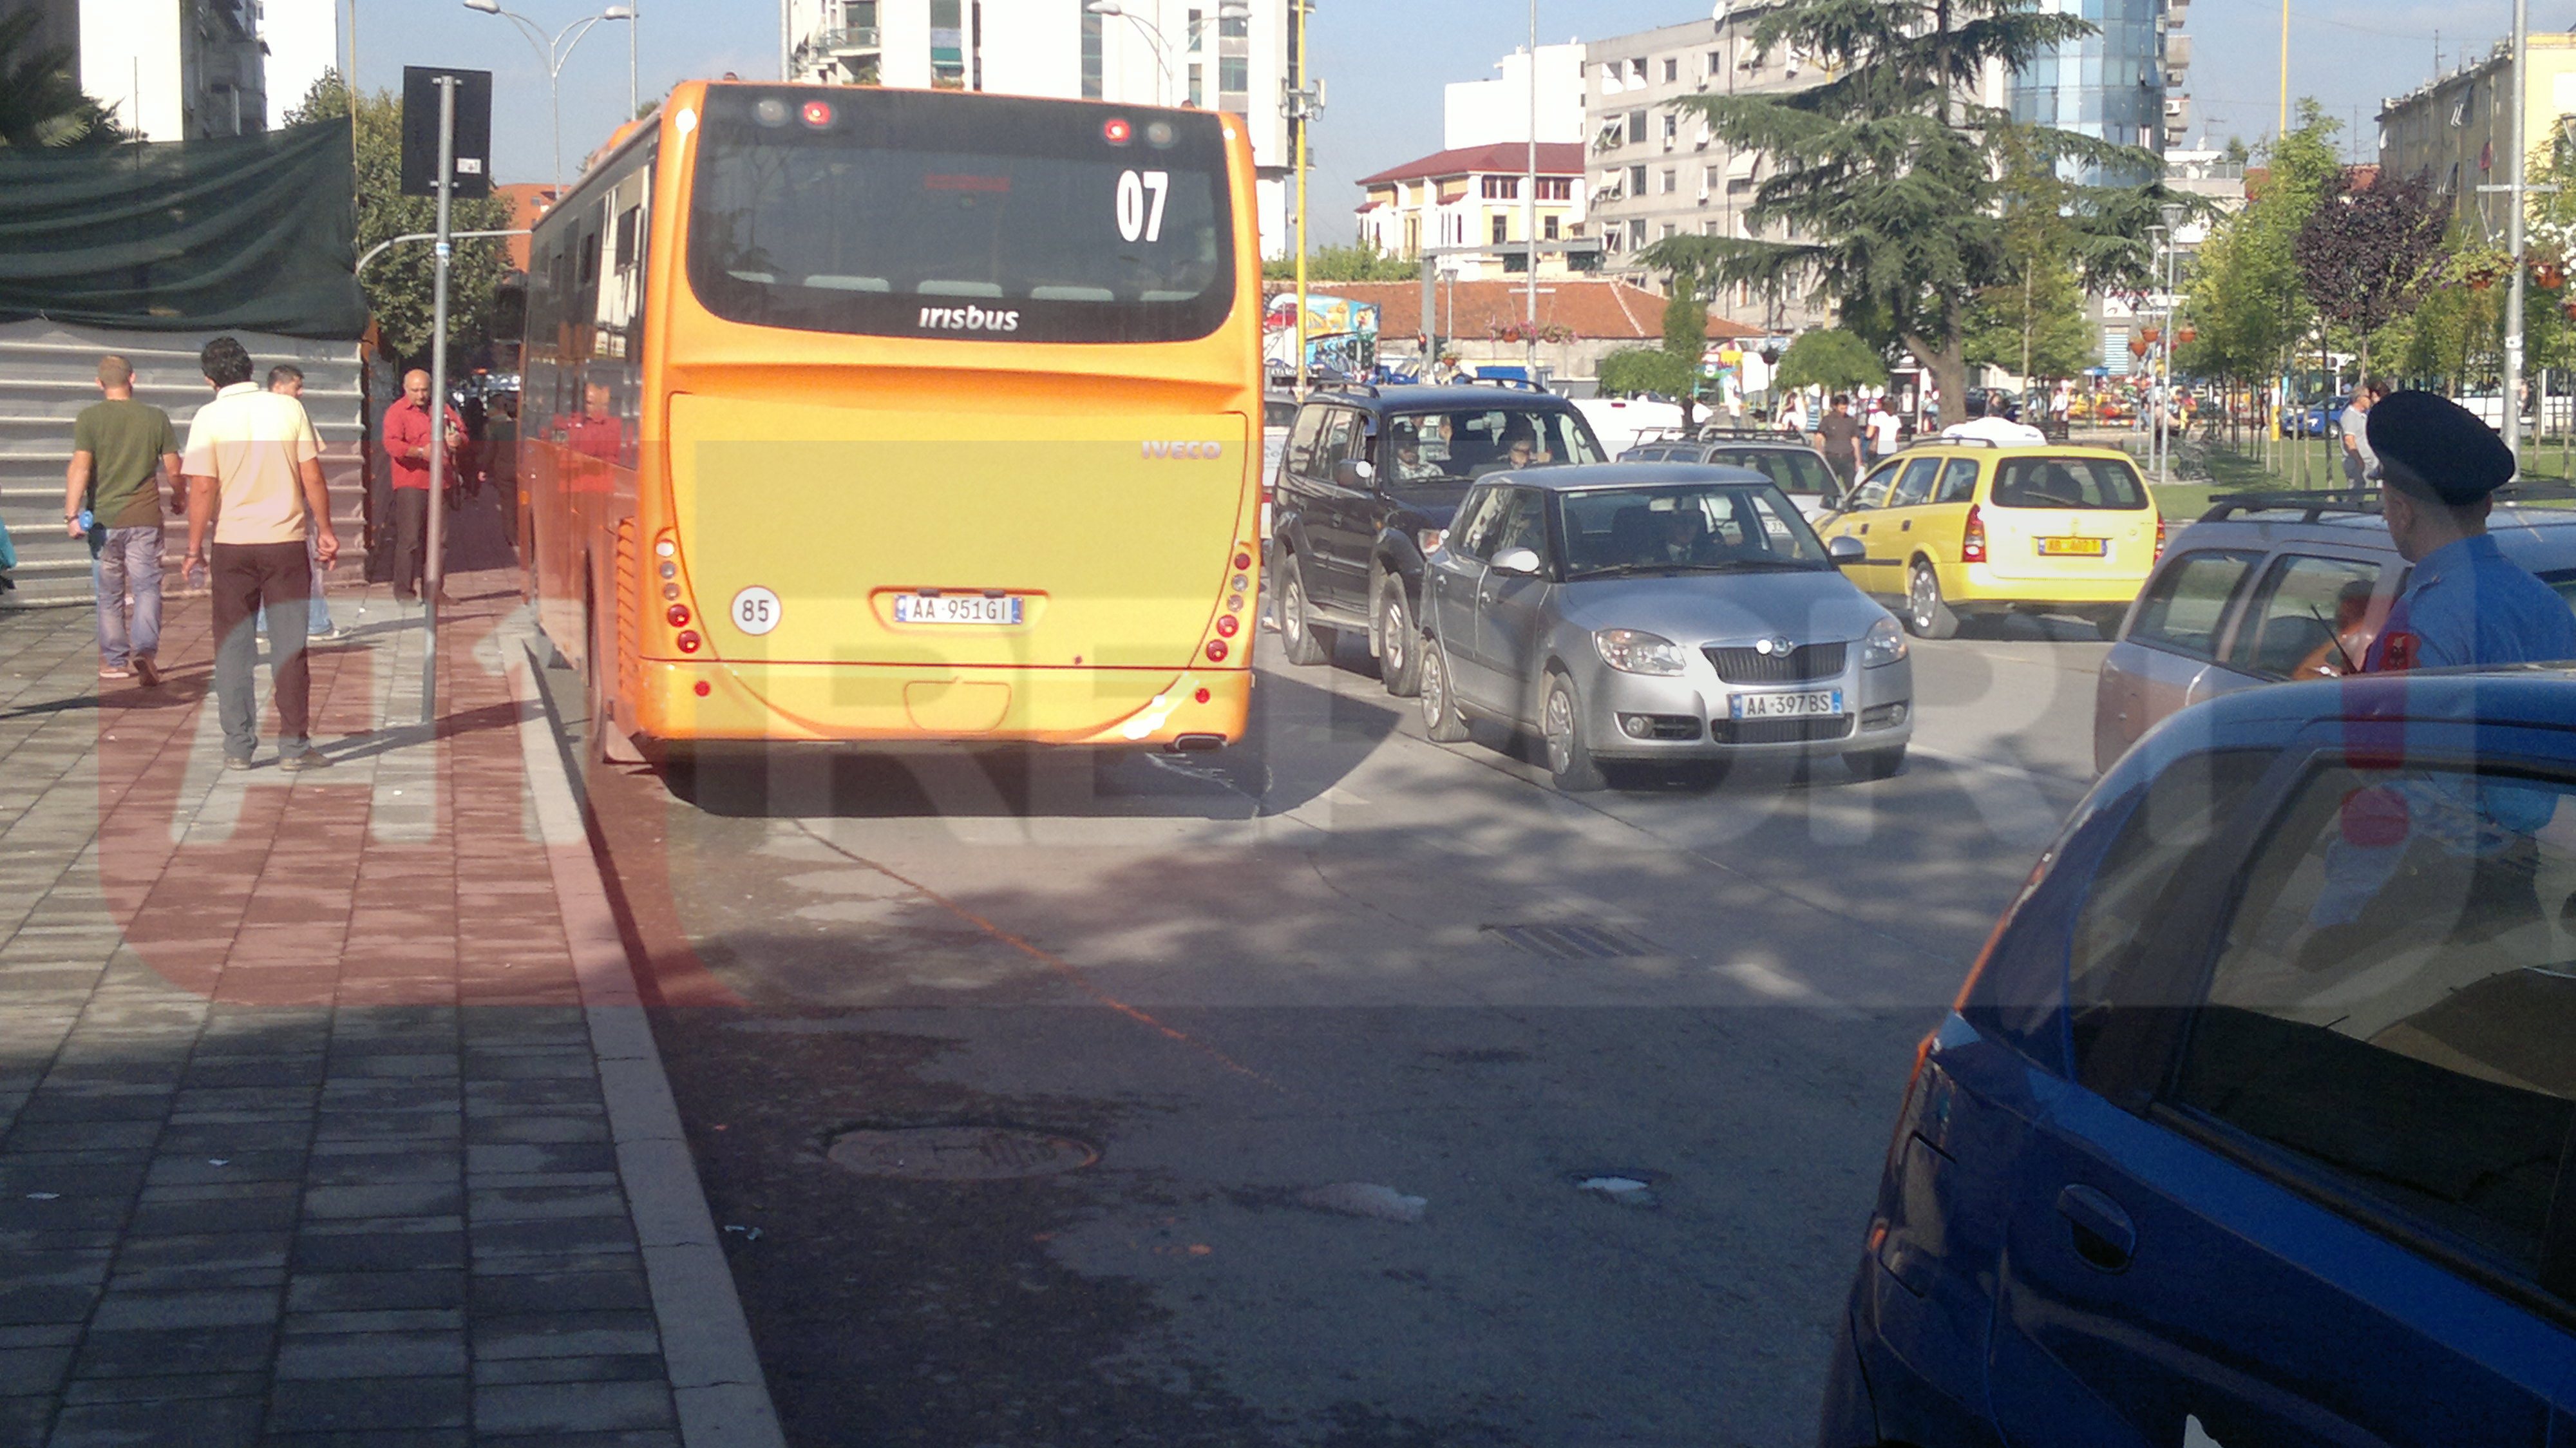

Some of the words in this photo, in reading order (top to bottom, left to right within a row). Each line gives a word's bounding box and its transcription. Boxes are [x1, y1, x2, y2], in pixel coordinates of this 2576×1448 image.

[1116, 169, 1168, 242] 07
[919, 304, 1019, 331] irisbus
[1142, 440, 1222, 459] IVECO
[742, 600, 769, 622] 85
[913, 599, 936, 618] AA
[1747, 697, 1766, 716] AA
